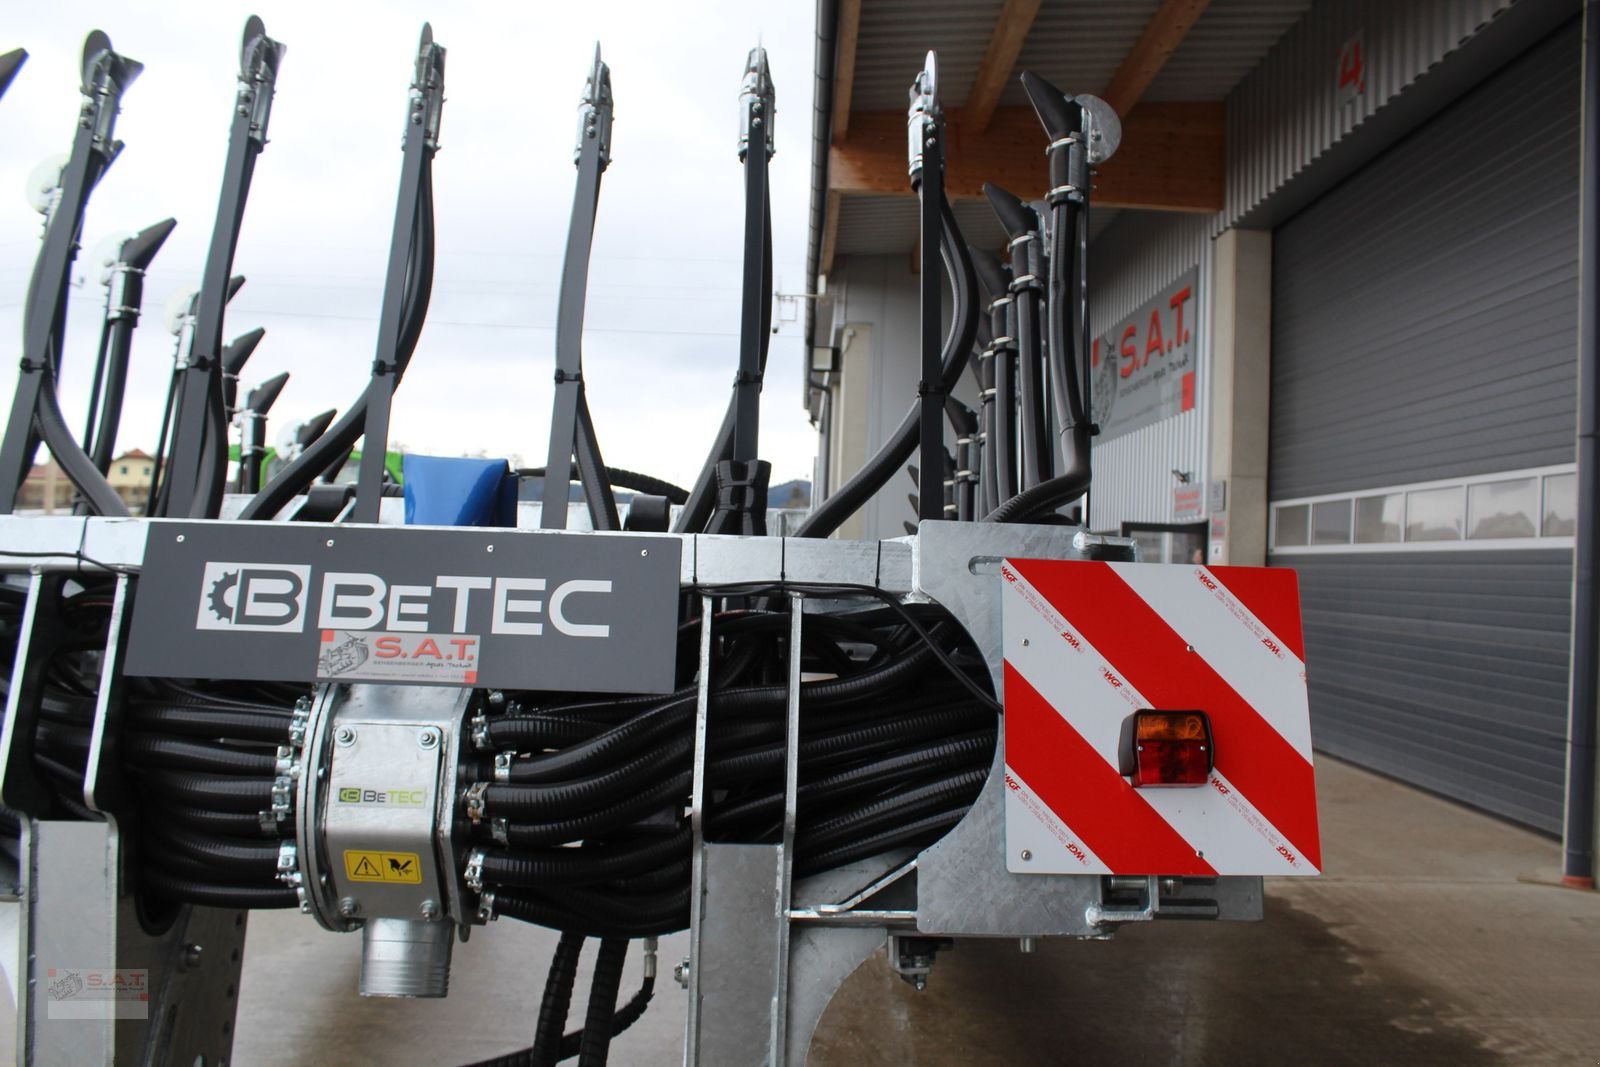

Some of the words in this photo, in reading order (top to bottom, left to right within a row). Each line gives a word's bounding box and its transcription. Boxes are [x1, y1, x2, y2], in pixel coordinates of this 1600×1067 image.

[1120, 286, 1191, 379] S.A.T.
[1001, 565, 1018, 584] WGF
[1199, 573, 1218, 591] WGF
[375, 636, 476, 661] S.A.T.
[1061, 630, 1080, 649] WGF
[1261, 637, 1281, 655] WGF
[1103, 670, 1123, 688] WGF
[1210, 777, 1230, 795] WGF
[1065, 842, 1086, 862] WGF
[1275, 845, 1296, 864] WGF
